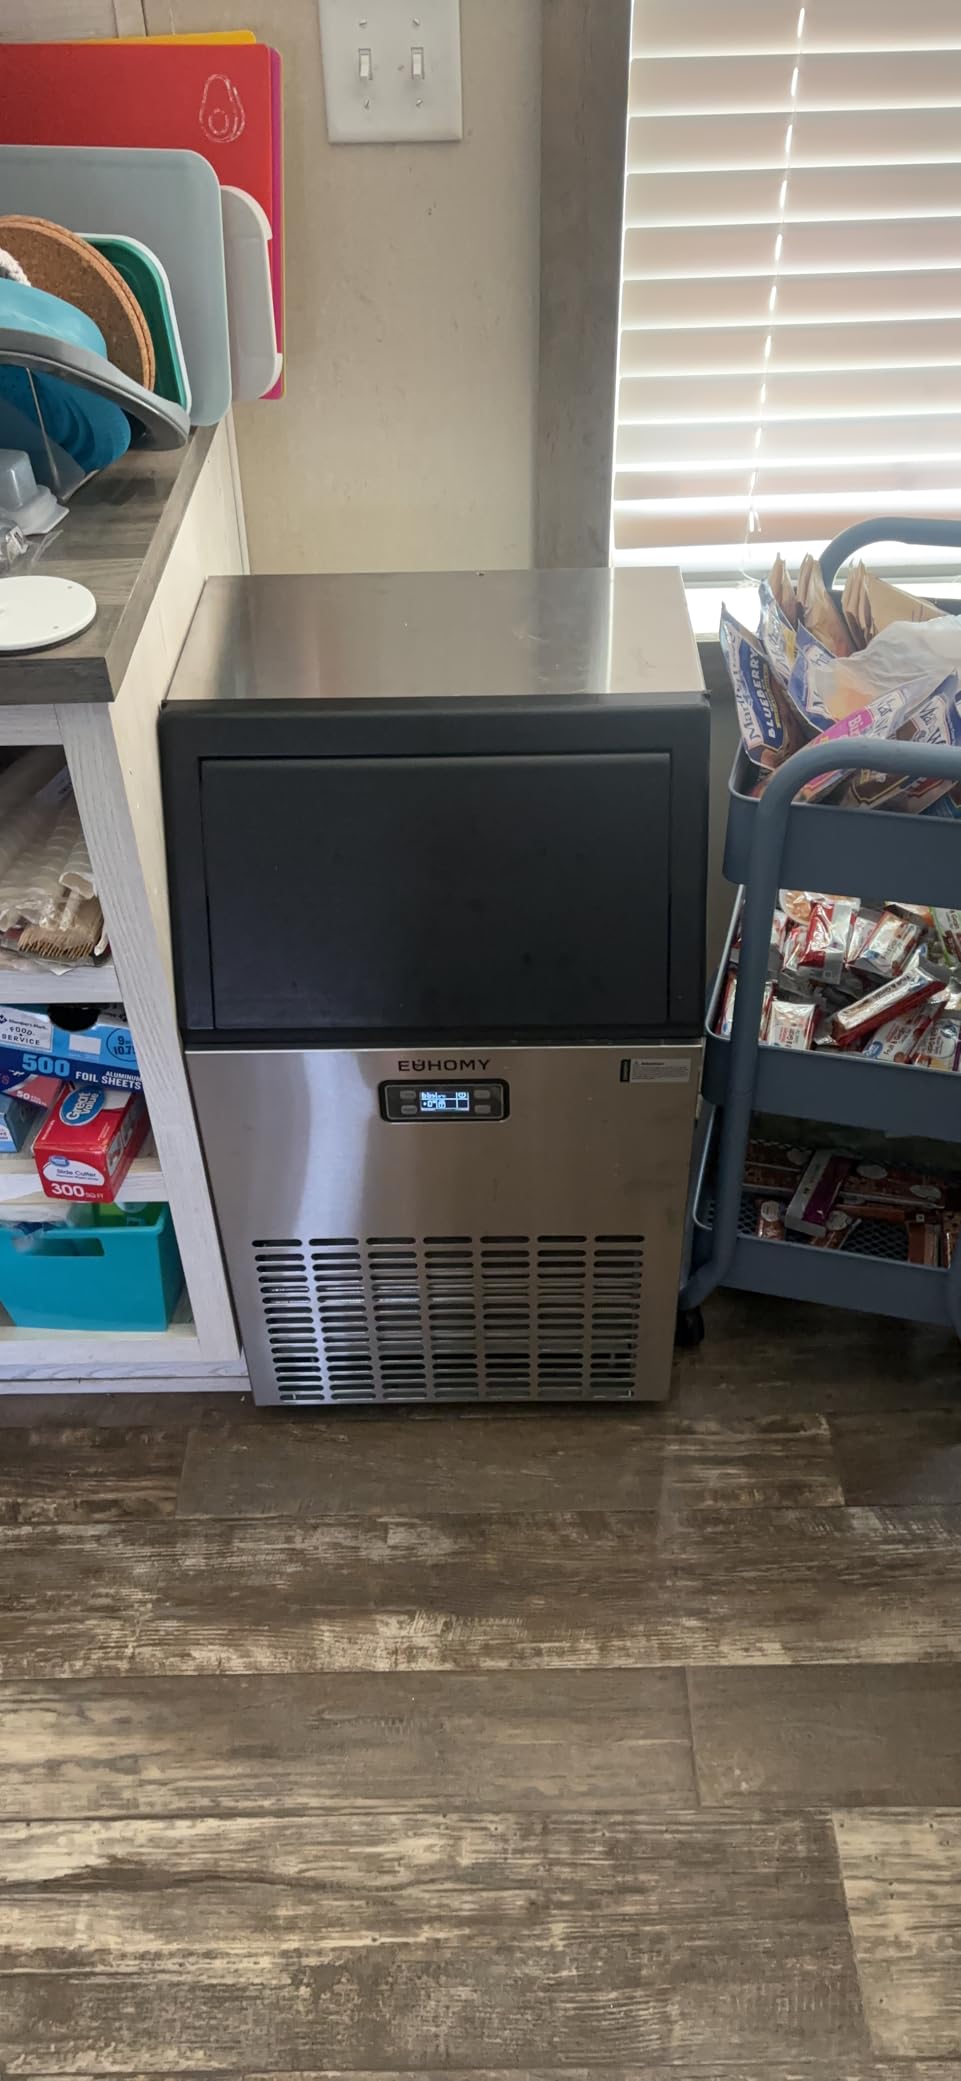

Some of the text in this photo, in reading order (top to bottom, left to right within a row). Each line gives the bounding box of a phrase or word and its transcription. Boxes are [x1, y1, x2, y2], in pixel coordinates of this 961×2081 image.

[751, 651, 777, 739] BLUEBERRY
[1, 1034, 41, 1046] SERVICE
[9, 1026, 33, 1036] FOOD
[117, 1035, 124, 1046] 9
[22, 1053, 71, 1077] 500
[75, 1070, 142, 1091] FOIL SHEETS
[66, 1091, 91, 1121] Great
[80, 1093, 99, 1115] Value
[51, 1183, 85, 1197] 300
